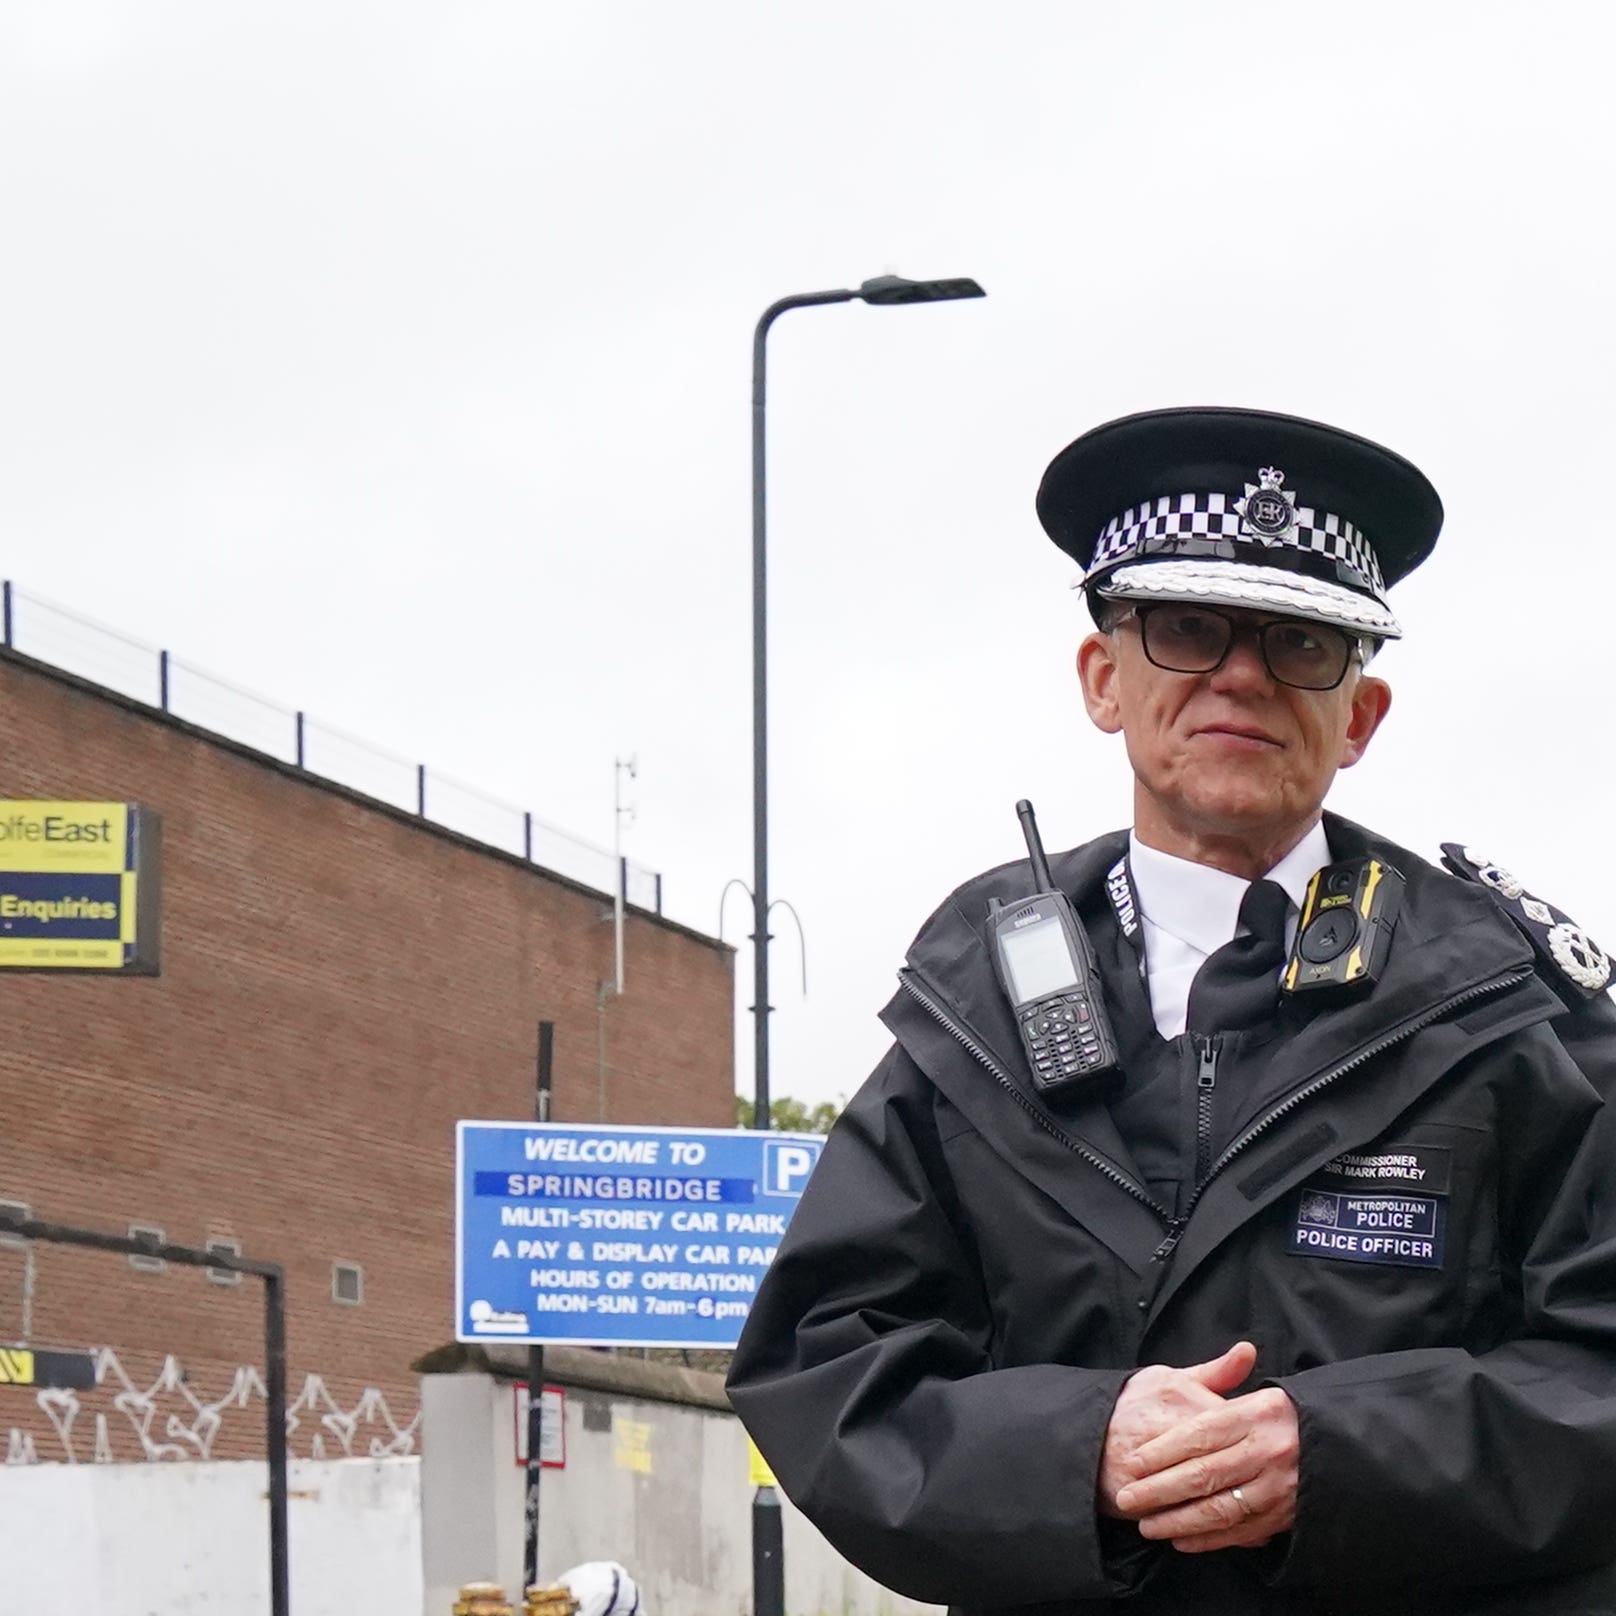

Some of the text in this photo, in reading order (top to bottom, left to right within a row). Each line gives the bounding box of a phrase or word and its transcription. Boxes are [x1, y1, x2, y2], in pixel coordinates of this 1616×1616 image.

[1, 894, 117, 923] Enquiries
[1108, 875, 1138, 937] POLICE
[525, 1137, 706, 1166] WELCOME TO
[776, 1146, 811, 1191] P
[1344, 1165, 1377, 1179] MARK
[1378, 1166, 1426, 1181] ROWLEY
[507, 1174, 722, 1201] SPRINGBRIDGE
[501, 1206, 786, 1235] MULTI-STOREY CAR PARK
[1347, 1201, 1426, 1214] METROPOLITAN
[1357, 1213, 1414, 1229] POLICE
[492, 1238, 777, 1267] A PAY & DISPLAY CAR PAR
[1297, 1230, 1434, 1258] POLICE OFFICER
[530, 1268, 756, 1292] HOURS OF OPERATION
[537, 1293, 638, 1314] MON-SUN
